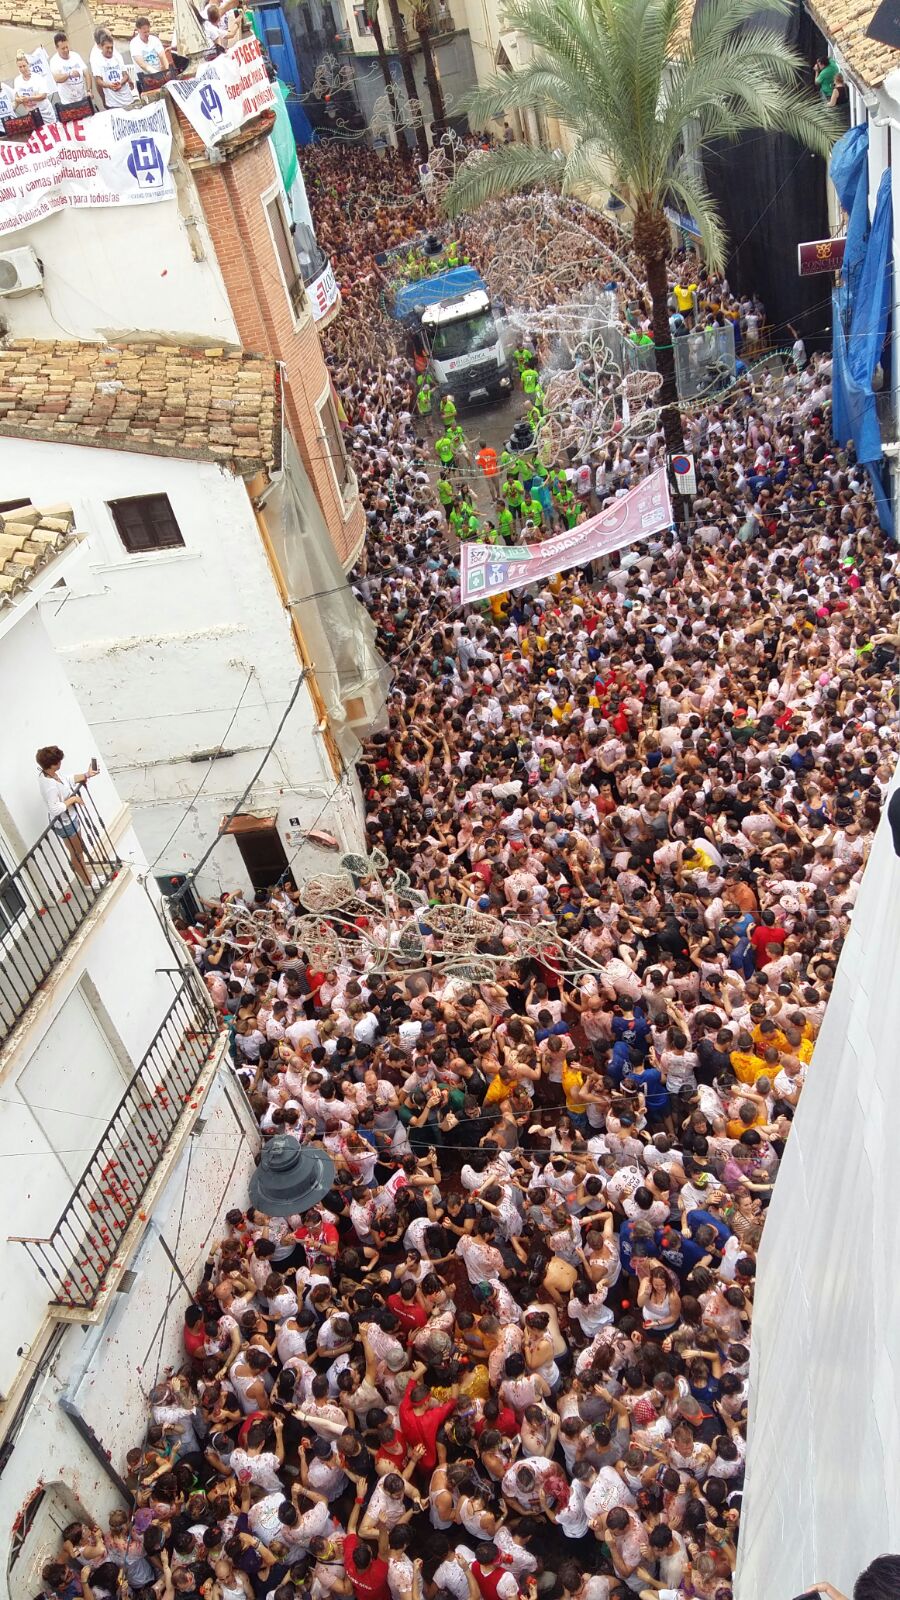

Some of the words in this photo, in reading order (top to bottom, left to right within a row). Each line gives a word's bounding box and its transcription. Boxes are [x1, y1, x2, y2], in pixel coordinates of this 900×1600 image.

[1, 120, 86, 165] URGENTE
[18, 186, 25, 198] y
[25, 176, 52, 192] camas
